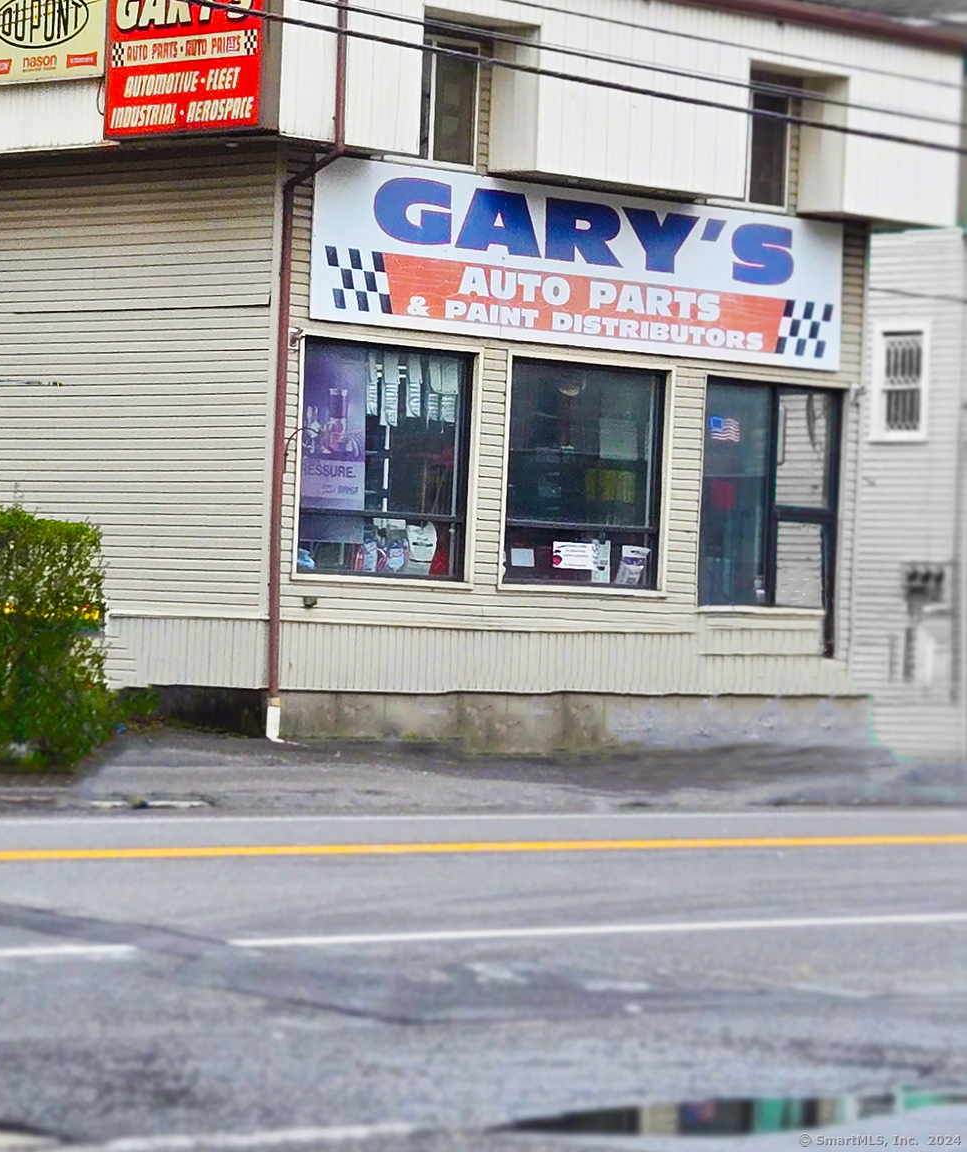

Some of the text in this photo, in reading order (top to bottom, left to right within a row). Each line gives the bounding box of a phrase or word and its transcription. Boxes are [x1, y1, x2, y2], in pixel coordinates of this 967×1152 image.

[23, 54, 57, 68] nason
[126, 44, 148, 62] AUTO
[151, 40, 178, 59] PARTS
[185, 38, 207, 57] AUTO
[123, 66, 241, 98] AUTOMOTIVE FLEET
[110, 96, 254, 129] INDUSTRIAL AEROSPACE
[374, 177, 794, 286] GARY'S
[458, 266, 721, 322] AUTO PARTS
[407, 296, 764, 351] & PAINT DISTRIBUTORS
